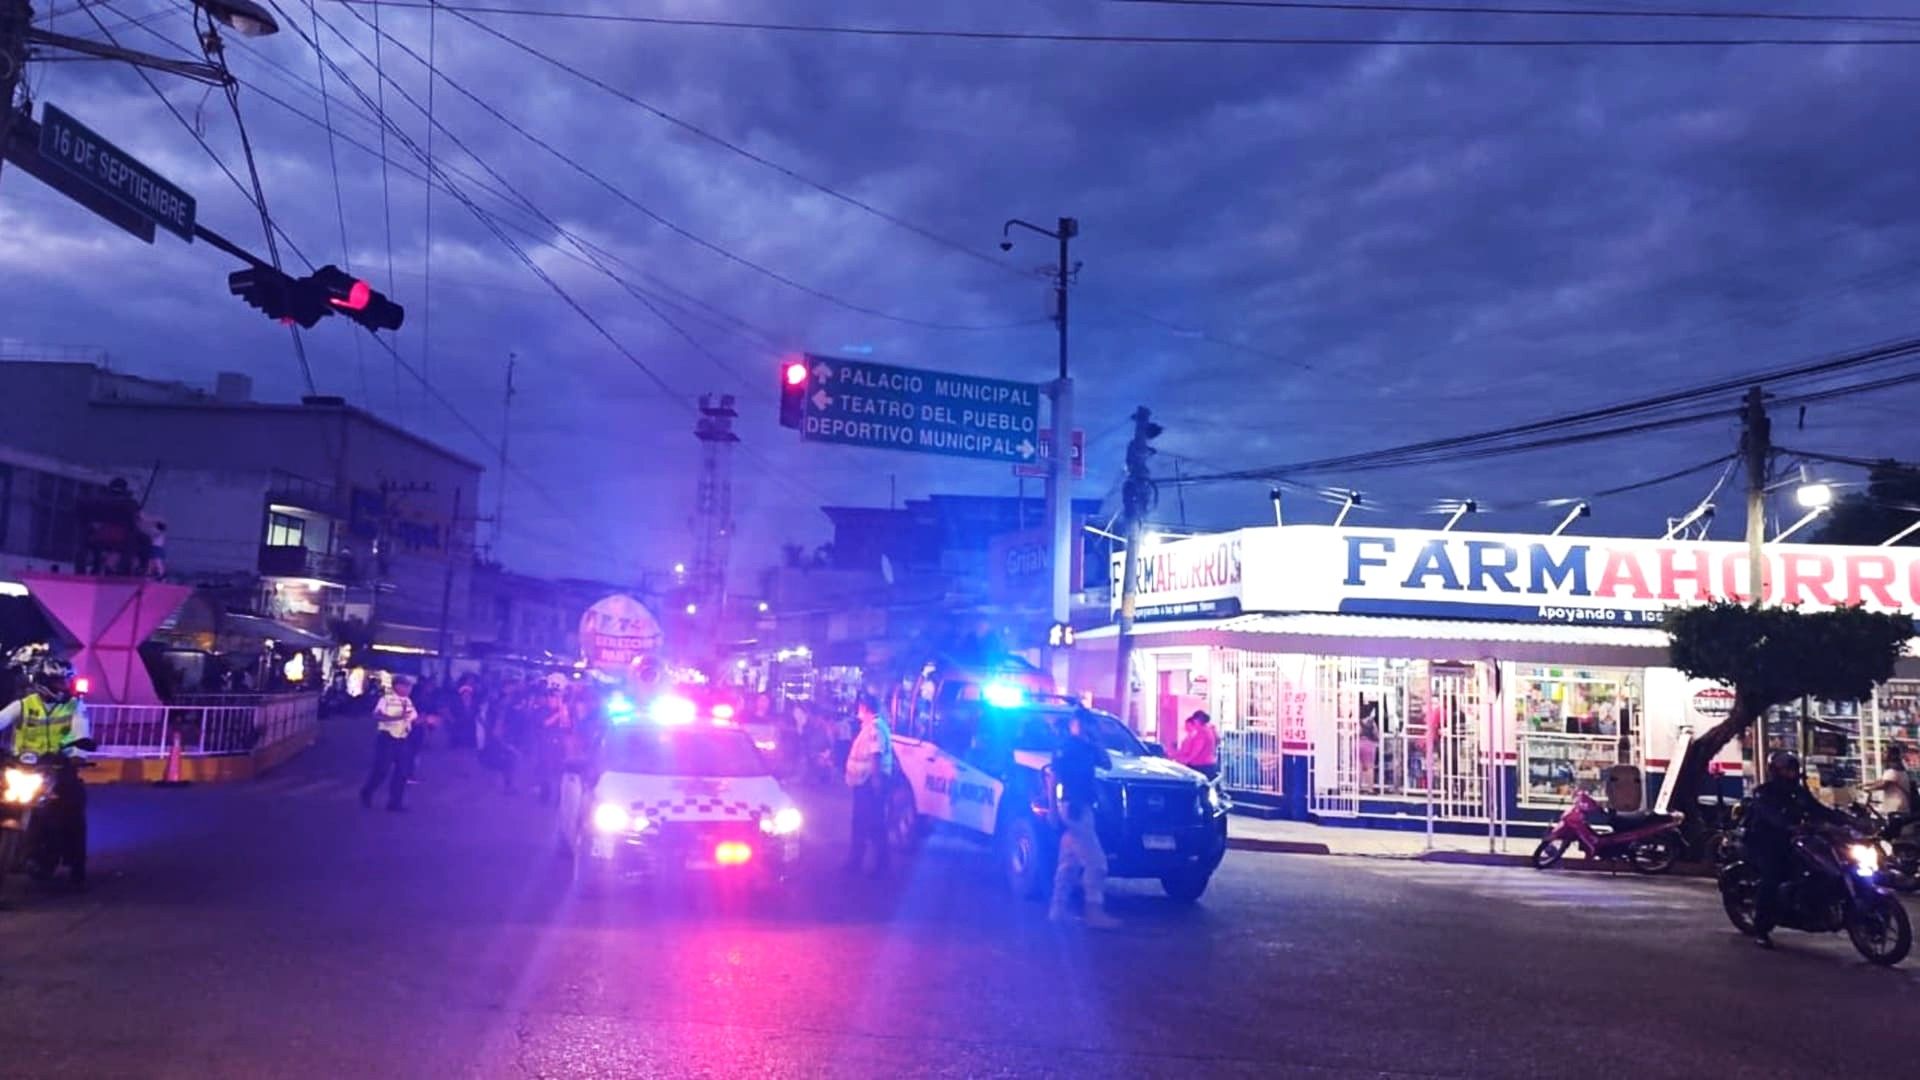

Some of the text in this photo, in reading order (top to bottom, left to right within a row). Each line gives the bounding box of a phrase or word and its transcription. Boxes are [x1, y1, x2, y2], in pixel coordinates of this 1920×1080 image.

[53, 125, 188, 226] 16 DE SEPTIEMBRE
[840, 367, 1032, 407] PALACIO MUNICIPAL
[840, 395, 1035, 433] TEATRO DEL PUEBLO
[806, 416, 914, 444] DEPORTIVO
[919, 429, 1016, 456] MUNICIPAL
[1343, 536, 1920, 607] FARMAHORR
[1538, 605, 1616, 622] Apoyando
[1623, 609, 1633, 621] a
